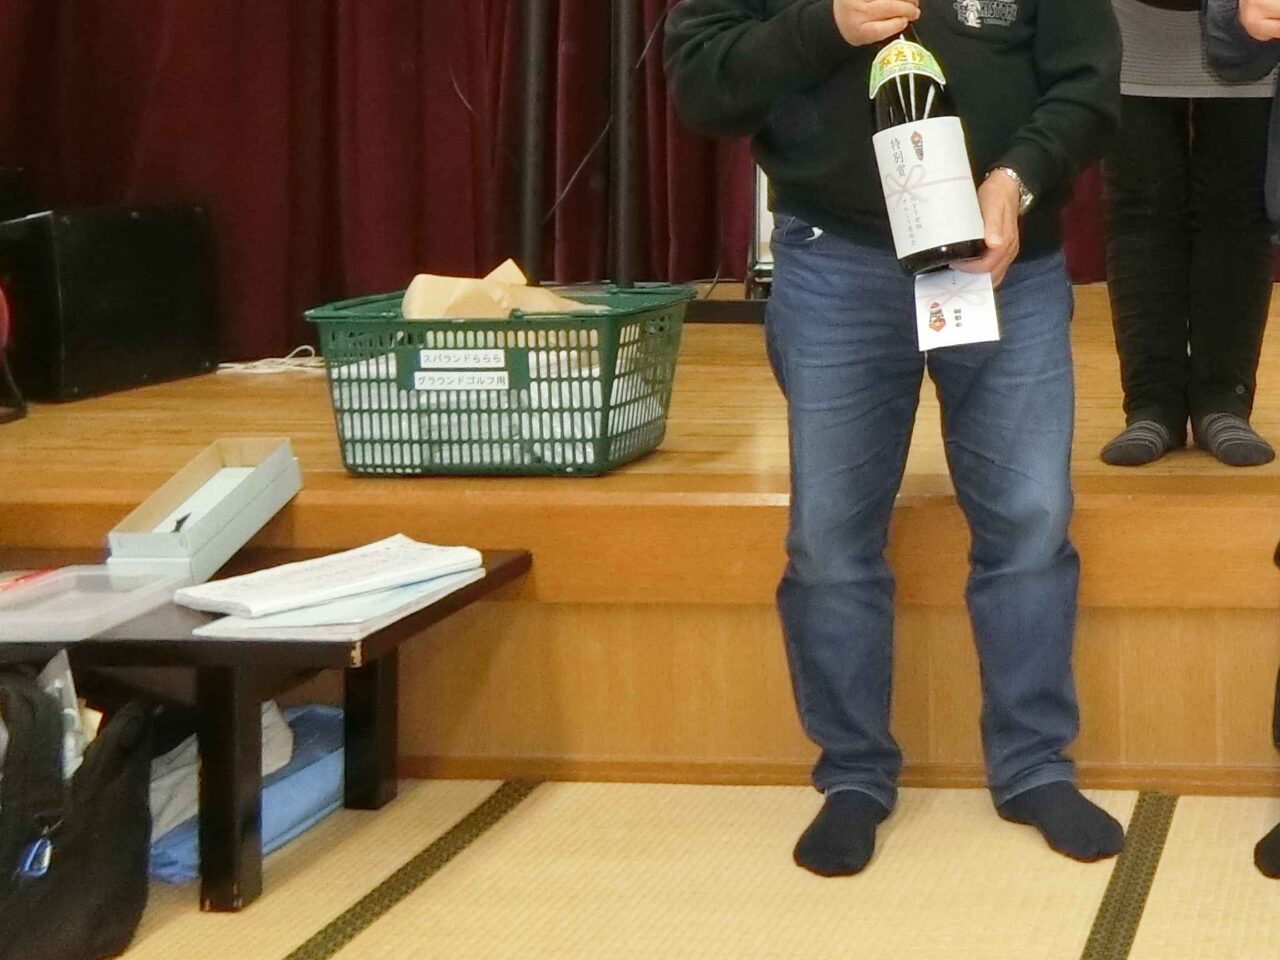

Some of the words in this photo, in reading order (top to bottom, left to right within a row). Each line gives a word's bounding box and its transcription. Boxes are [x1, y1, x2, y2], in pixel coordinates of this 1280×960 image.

[419, 375, 506, 386] グラウンドゴルフ用
